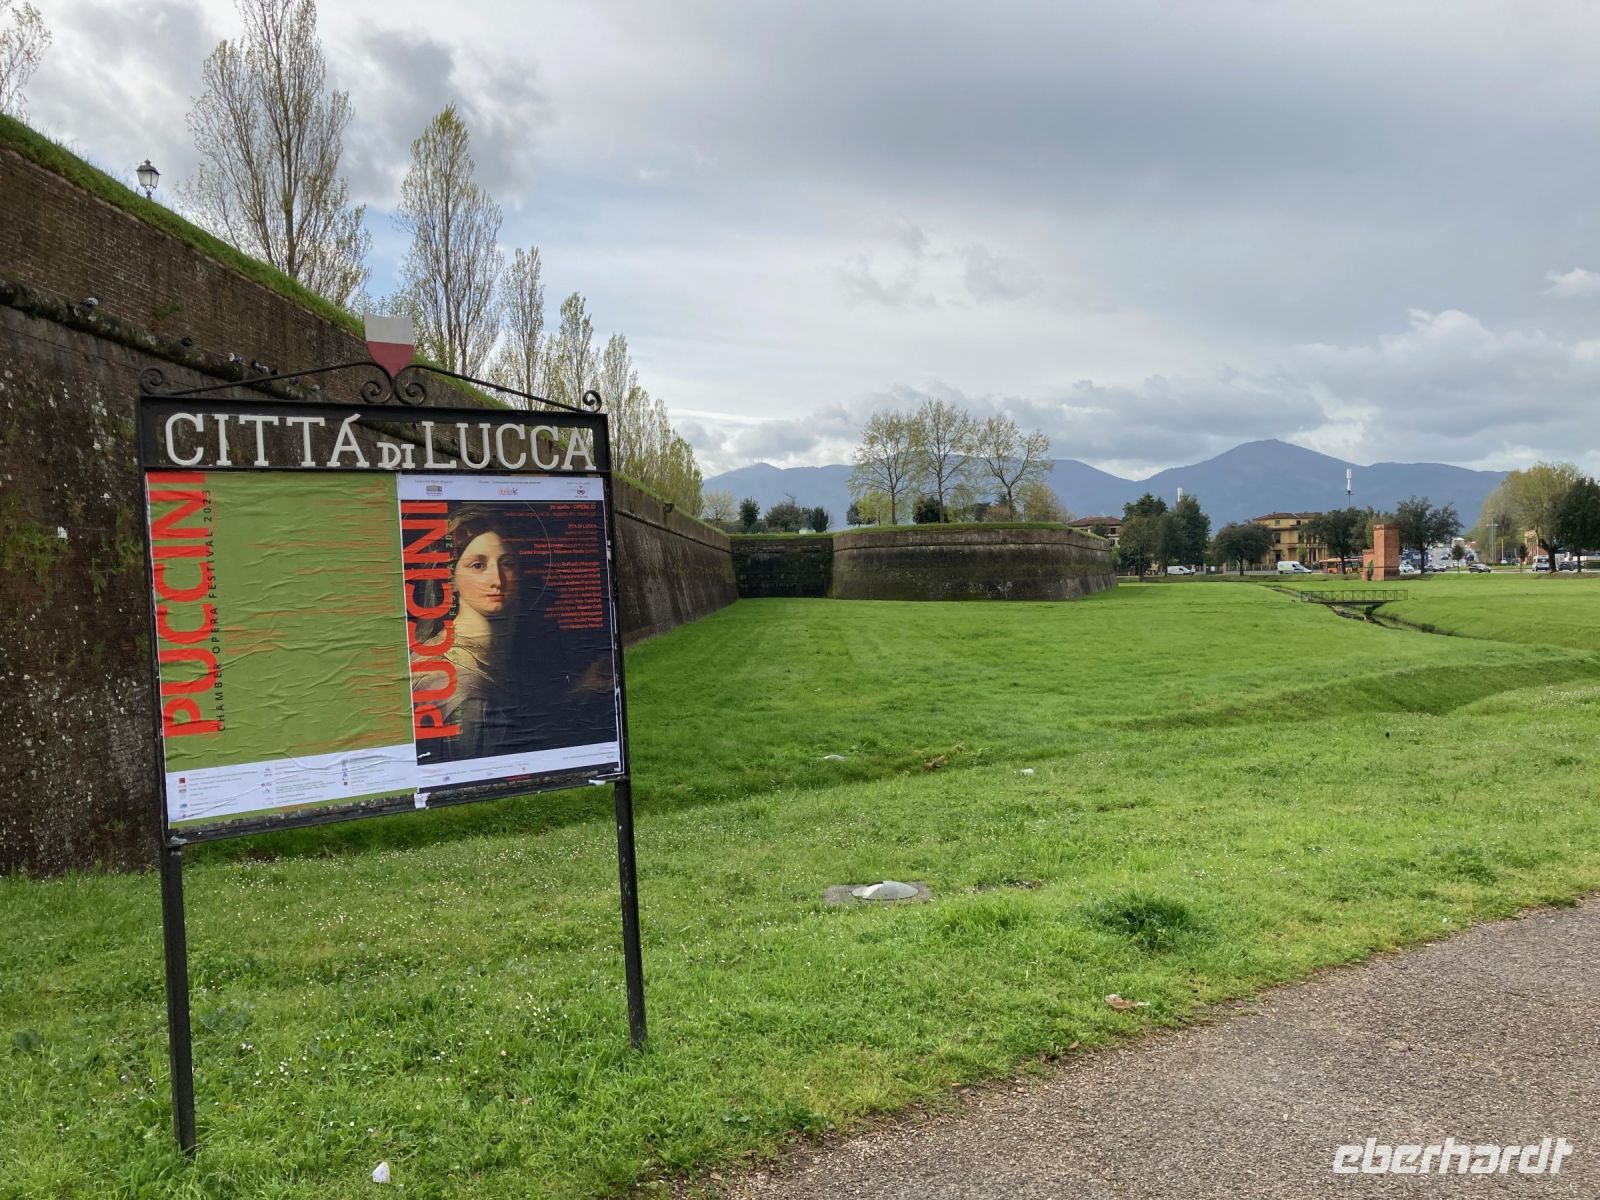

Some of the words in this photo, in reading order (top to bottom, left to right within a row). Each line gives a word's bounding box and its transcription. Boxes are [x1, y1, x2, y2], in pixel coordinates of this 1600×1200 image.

[377, 441, 415, 469] DI
[422, 421, 597, 471] LUCCA
[202, 489, 213, 523] 2023
[204, 531, 217, 599] FESTIVAL
[146, 472, 223, 738] PUCCINI
[209, 607, 221, 654] OPERA
[401, 503, 460, 740] PUCCINI
[213, 662, 227, 733] CHAMBER
